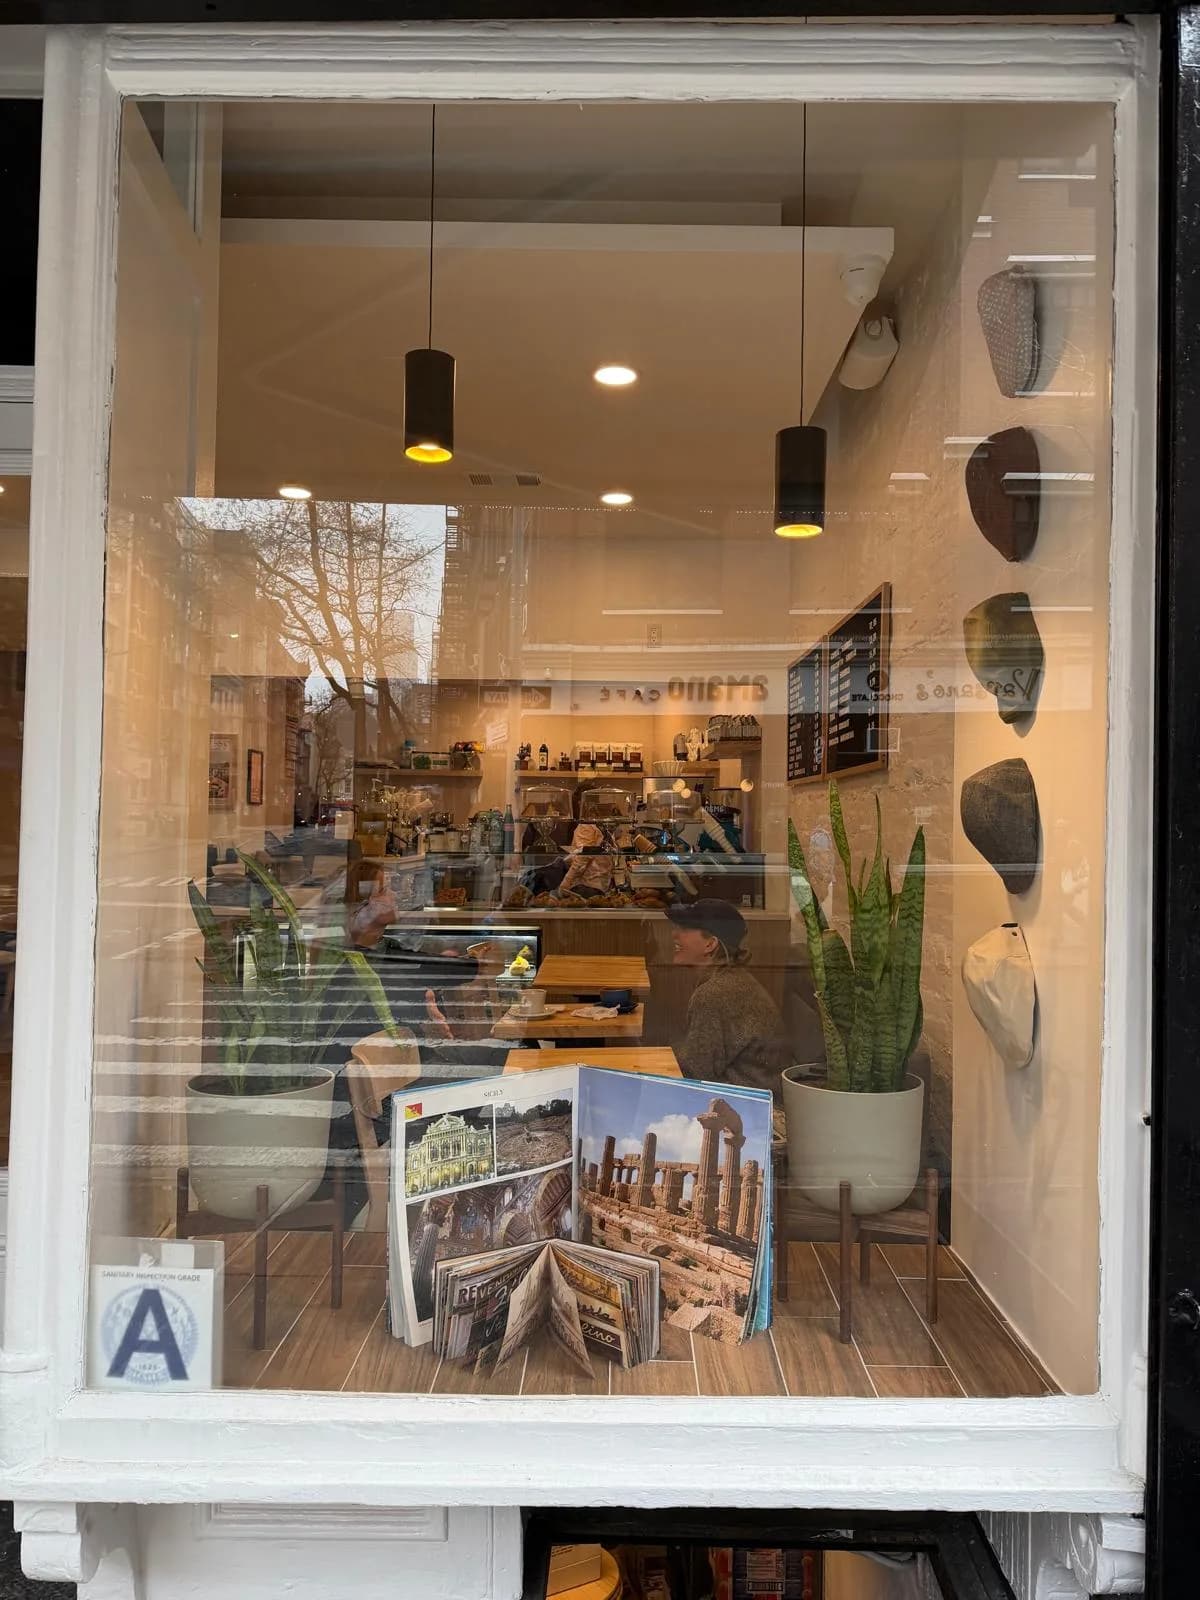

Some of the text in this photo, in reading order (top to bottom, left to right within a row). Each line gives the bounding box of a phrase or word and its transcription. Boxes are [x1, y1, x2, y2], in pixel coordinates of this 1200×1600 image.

[136, 1272, 177, 1281] INSPECTION
[177, 1273, 201, 1282] GRADE
[106, 1288, 190, 1381] A
